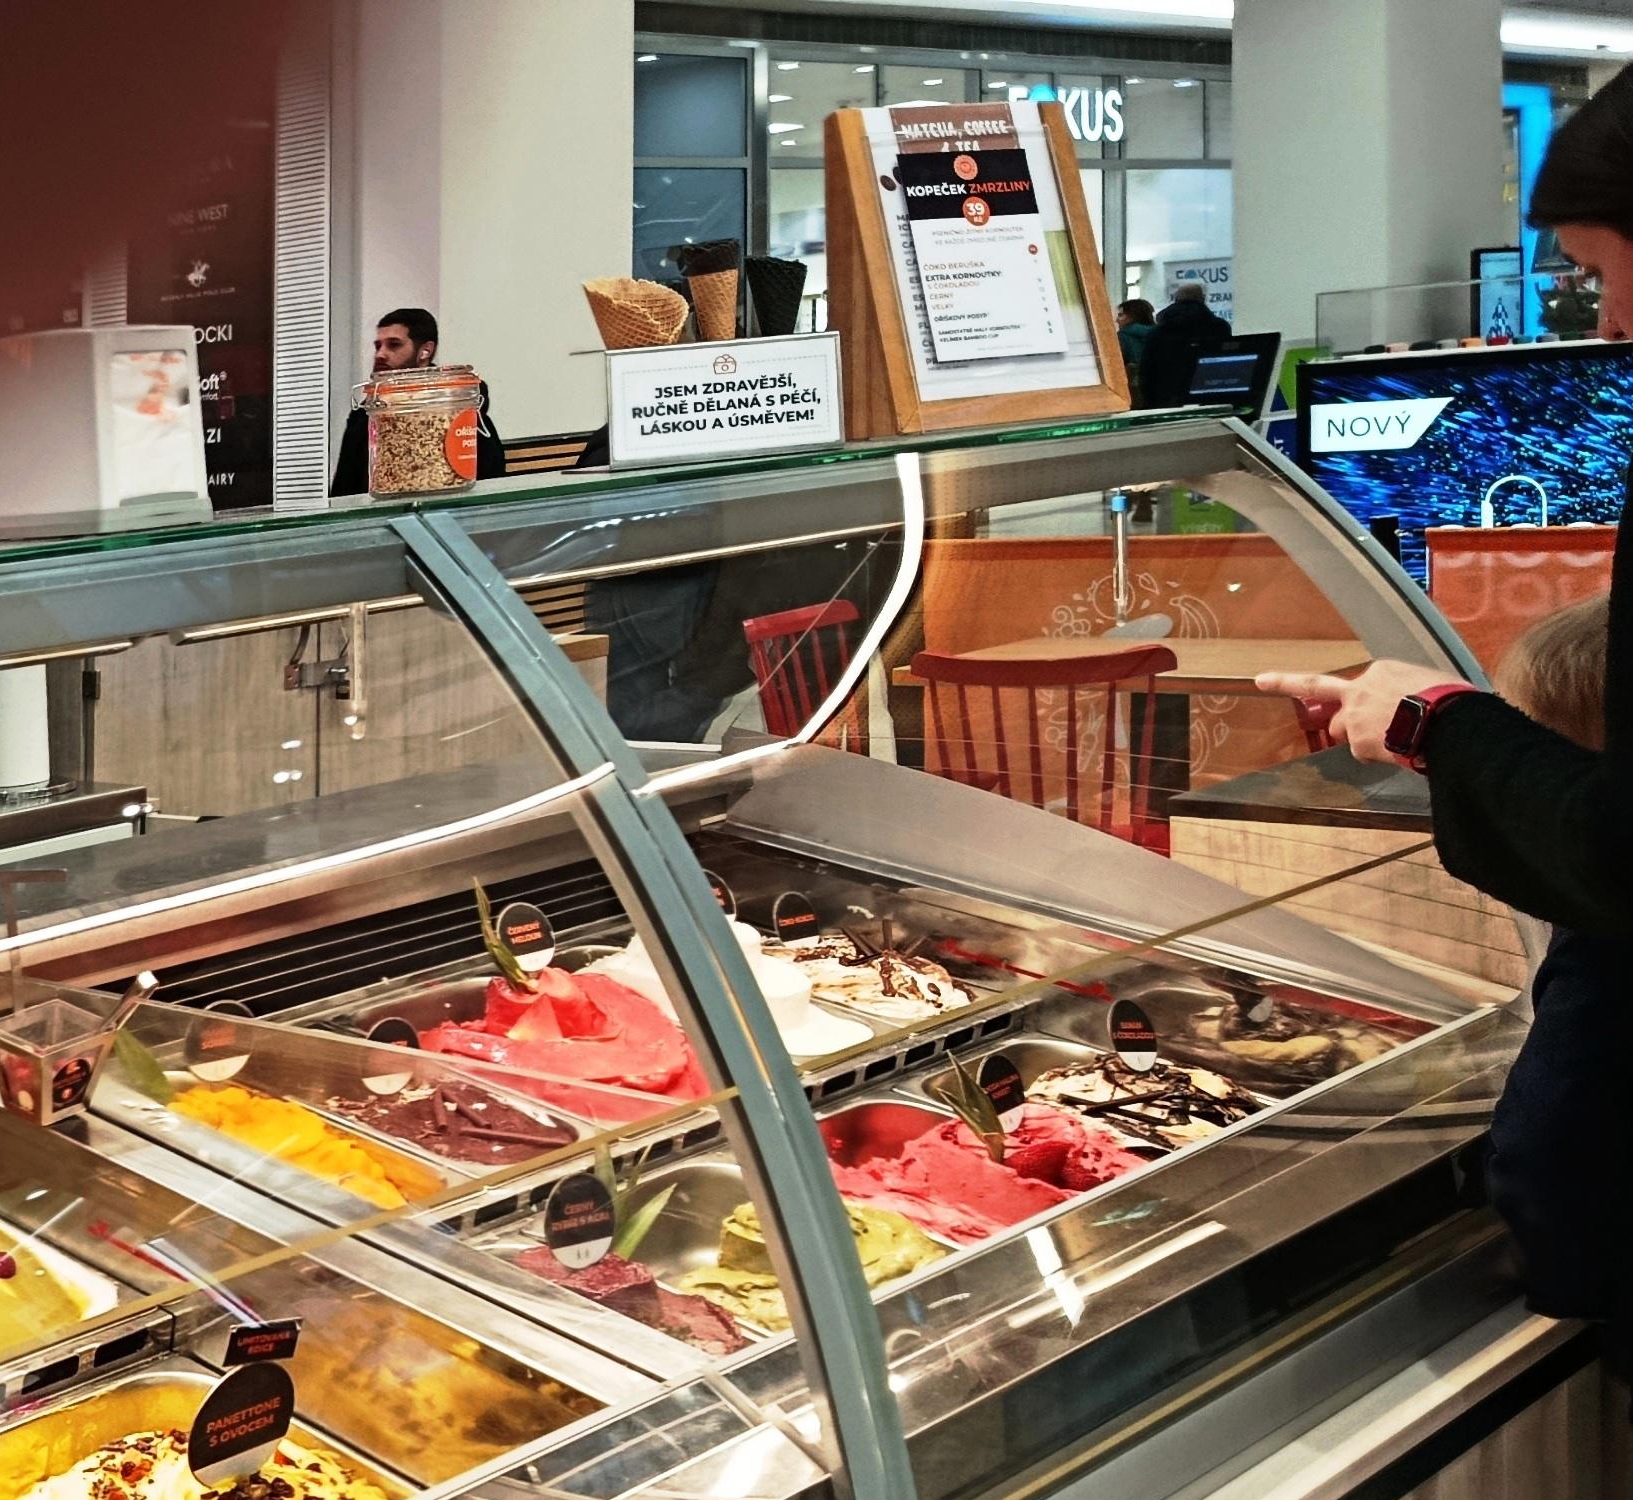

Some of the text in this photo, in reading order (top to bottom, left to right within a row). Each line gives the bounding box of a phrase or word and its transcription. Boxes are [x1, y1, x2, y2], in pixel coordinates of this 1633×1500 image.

[906, 180, 1031, 197] KOPEČEK ZMRZLINY
[966, 202, 985, 216] 39
[925, 273, 951, 282] EXTRA
[654, 372, 797, 399] JSEM ZDRAVĚJŠÍ,
[631, 388, 822, 419] RUČNĚ DĚLANÁ S PÉČÍ,
[640, 408, 815, 436] LÁSKOU A ÚSMĚVEM!
[1327, 410, 1413, 439] NOVÝ
[205, 1396, 283, 1434] PANETTONE
[209, 1415, 275, 1448] S OVOCEM
